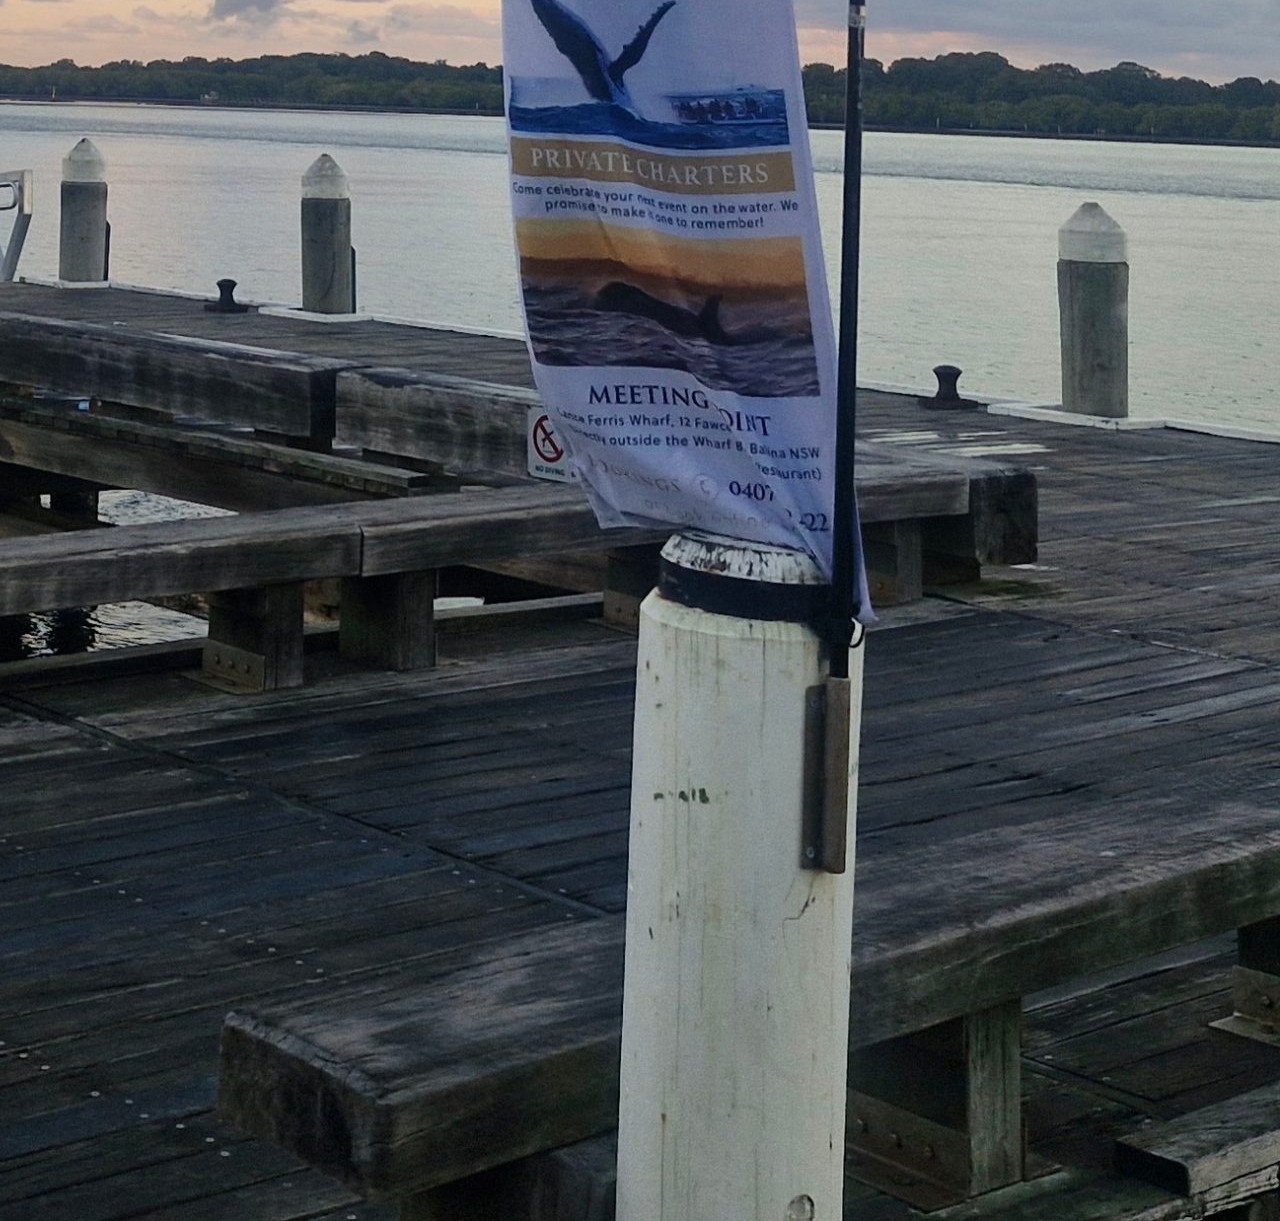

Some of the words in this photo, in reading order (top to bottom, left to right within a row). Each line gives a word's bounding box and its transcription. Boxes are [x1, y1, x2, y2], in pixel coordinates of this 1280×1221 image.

[530, 147, 634, 174] PRIVATE
[636, 158, 769, 186] CHARTERS
[512, 181, 542, 195] Come
[603, 192, 633, 203] your
[691, 204, 708, 214] on
[713, 203, 736, 214] the
[738, 201, 776, 213] water.
[780, 199, 799, 211] We
[545, 199, 595, 212] promise
[611, 206, 646, 218] make
[655, 213, 674, 225] one
[676, 217, 687, 228] to
[691, 216, 764, 230] remember!
[587, 414, 625, 427] Ferris
[679, 416, 691, 428] 12
[589, 384, 709, 410] MEETING
[714, 405, 772, 437] OINT
[609, 434, 661, 447] outside
[665, 434, 689, 447] the
[692, 435, 731, 450] Wharf
[789, 447, 820, 459] NSW
